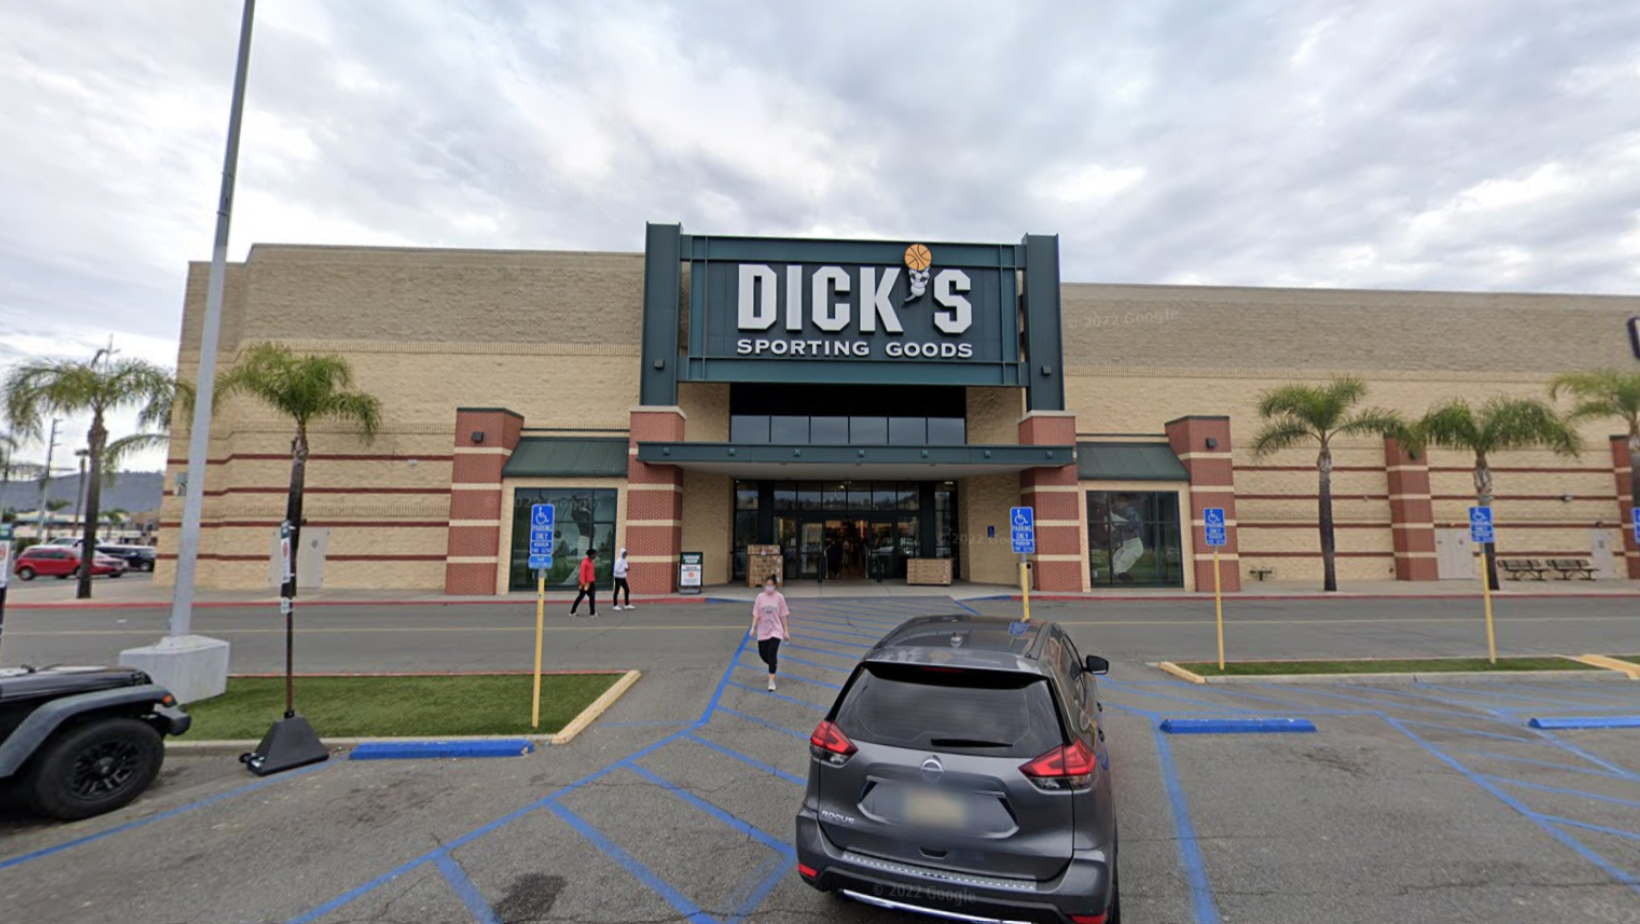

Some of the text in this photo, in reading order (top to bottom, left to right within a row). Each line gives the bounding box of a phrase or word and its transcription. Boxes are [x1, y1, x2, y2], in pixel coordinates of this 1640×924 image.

[738, 262, 973, 335] DICK'S
[737, 339, 974, 359] SPORTING GOODS
[1012, 525, 1032, 533] PARKING
